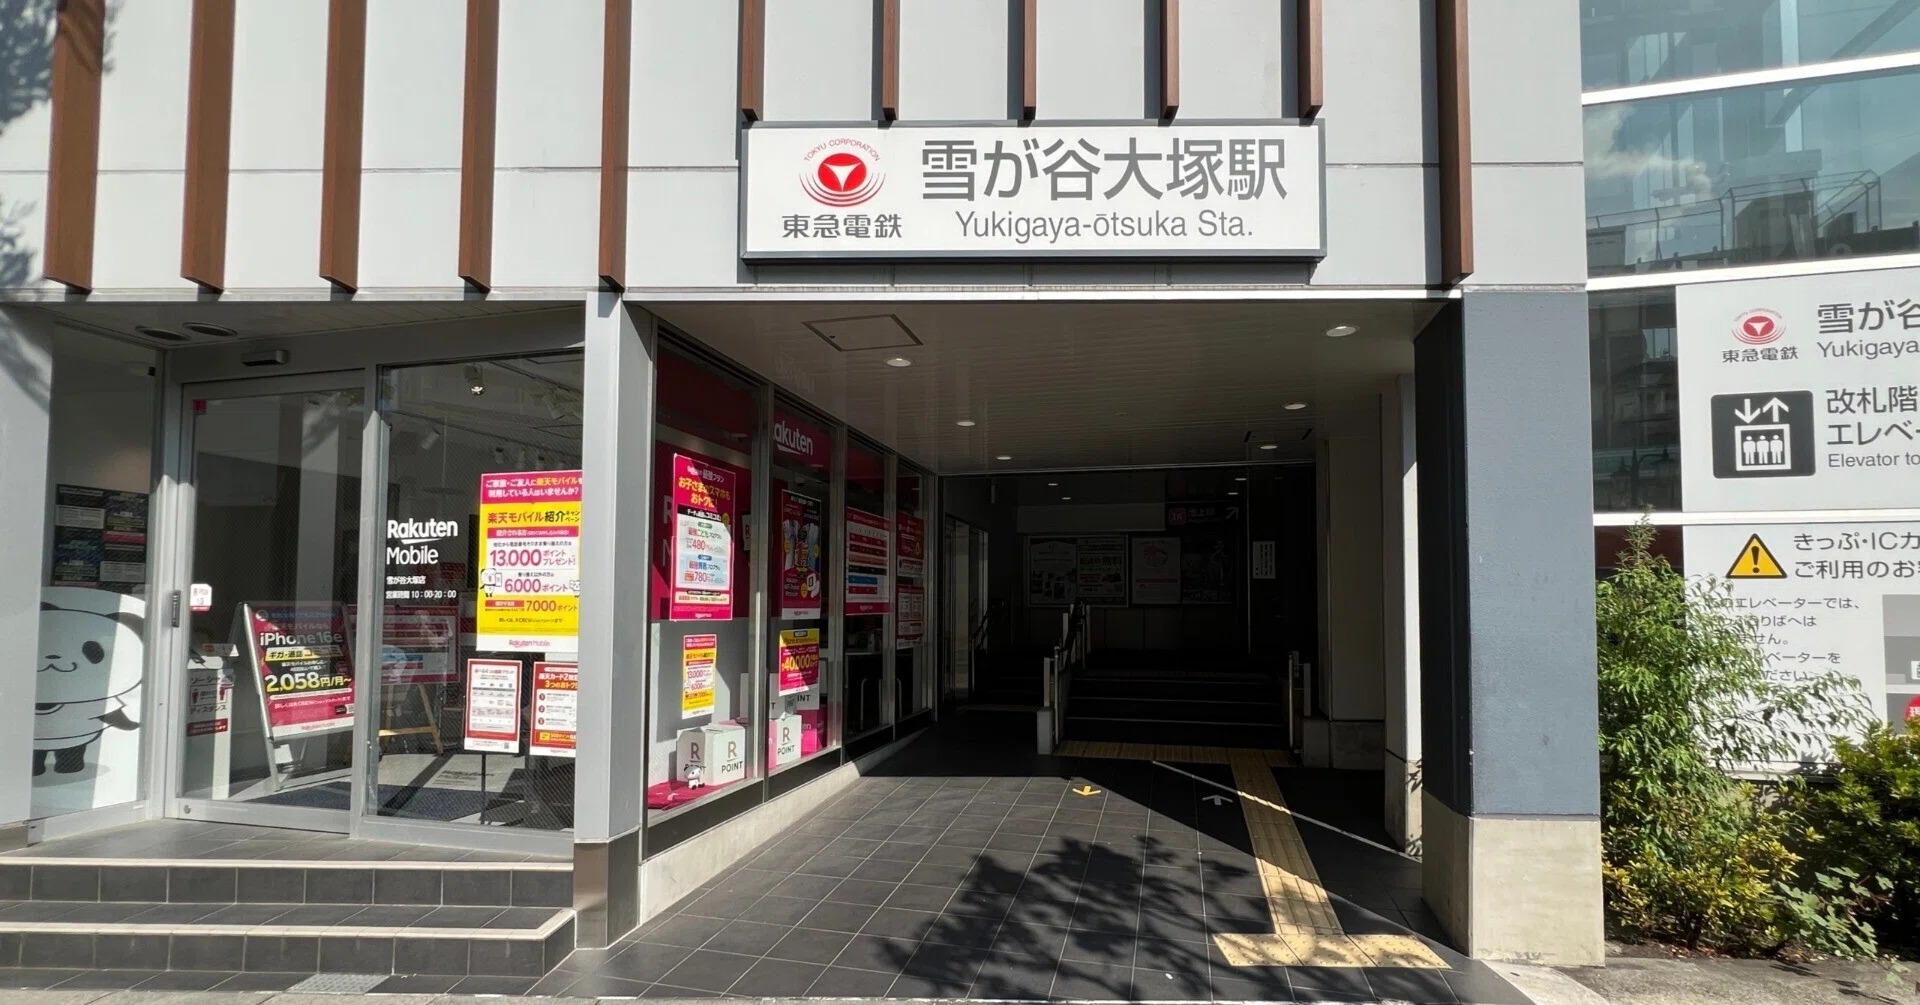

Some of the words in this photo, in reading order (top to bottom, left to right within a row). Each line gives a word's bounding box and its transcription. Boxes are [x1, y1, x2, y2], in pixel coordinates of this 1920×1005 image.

[804, 143, 827, 161] TOKYU
[829, 138, 881, 161] CORPORATION
[922, 137, 1288, 201] 雪が谷大塚駅
[782, 214, 903, 239] 東急電鉄
[955, 210, 1188, 244] Yukigaya-ōtsuka
[1198, 209, 1254, 237] Sta.
[1722, 346, 1799, 363] 東急電鉄
[1816, 339, 1920, 360] Yukigaya
[1826, 385, 1919, 415] 改札階
[773, 420, 814, 456] akuten
[1827, 420, 1920, 446] エレベ
[1828, 453, 1900, 467] Elevator
[387, 518, 459, 539] Rakuten
[386, 545, 439, 565] Mobile
[490, 549, 542, 567] 13,000
[1795, 560, 1920, 579] ご利用のお
[783, 727, 791, 743] R
[691, 742, 701, 760] R
[728, 741, 738, 758] R
[777, 745, 795, 756] POINT
[721, 761, 743, 774] POINT
